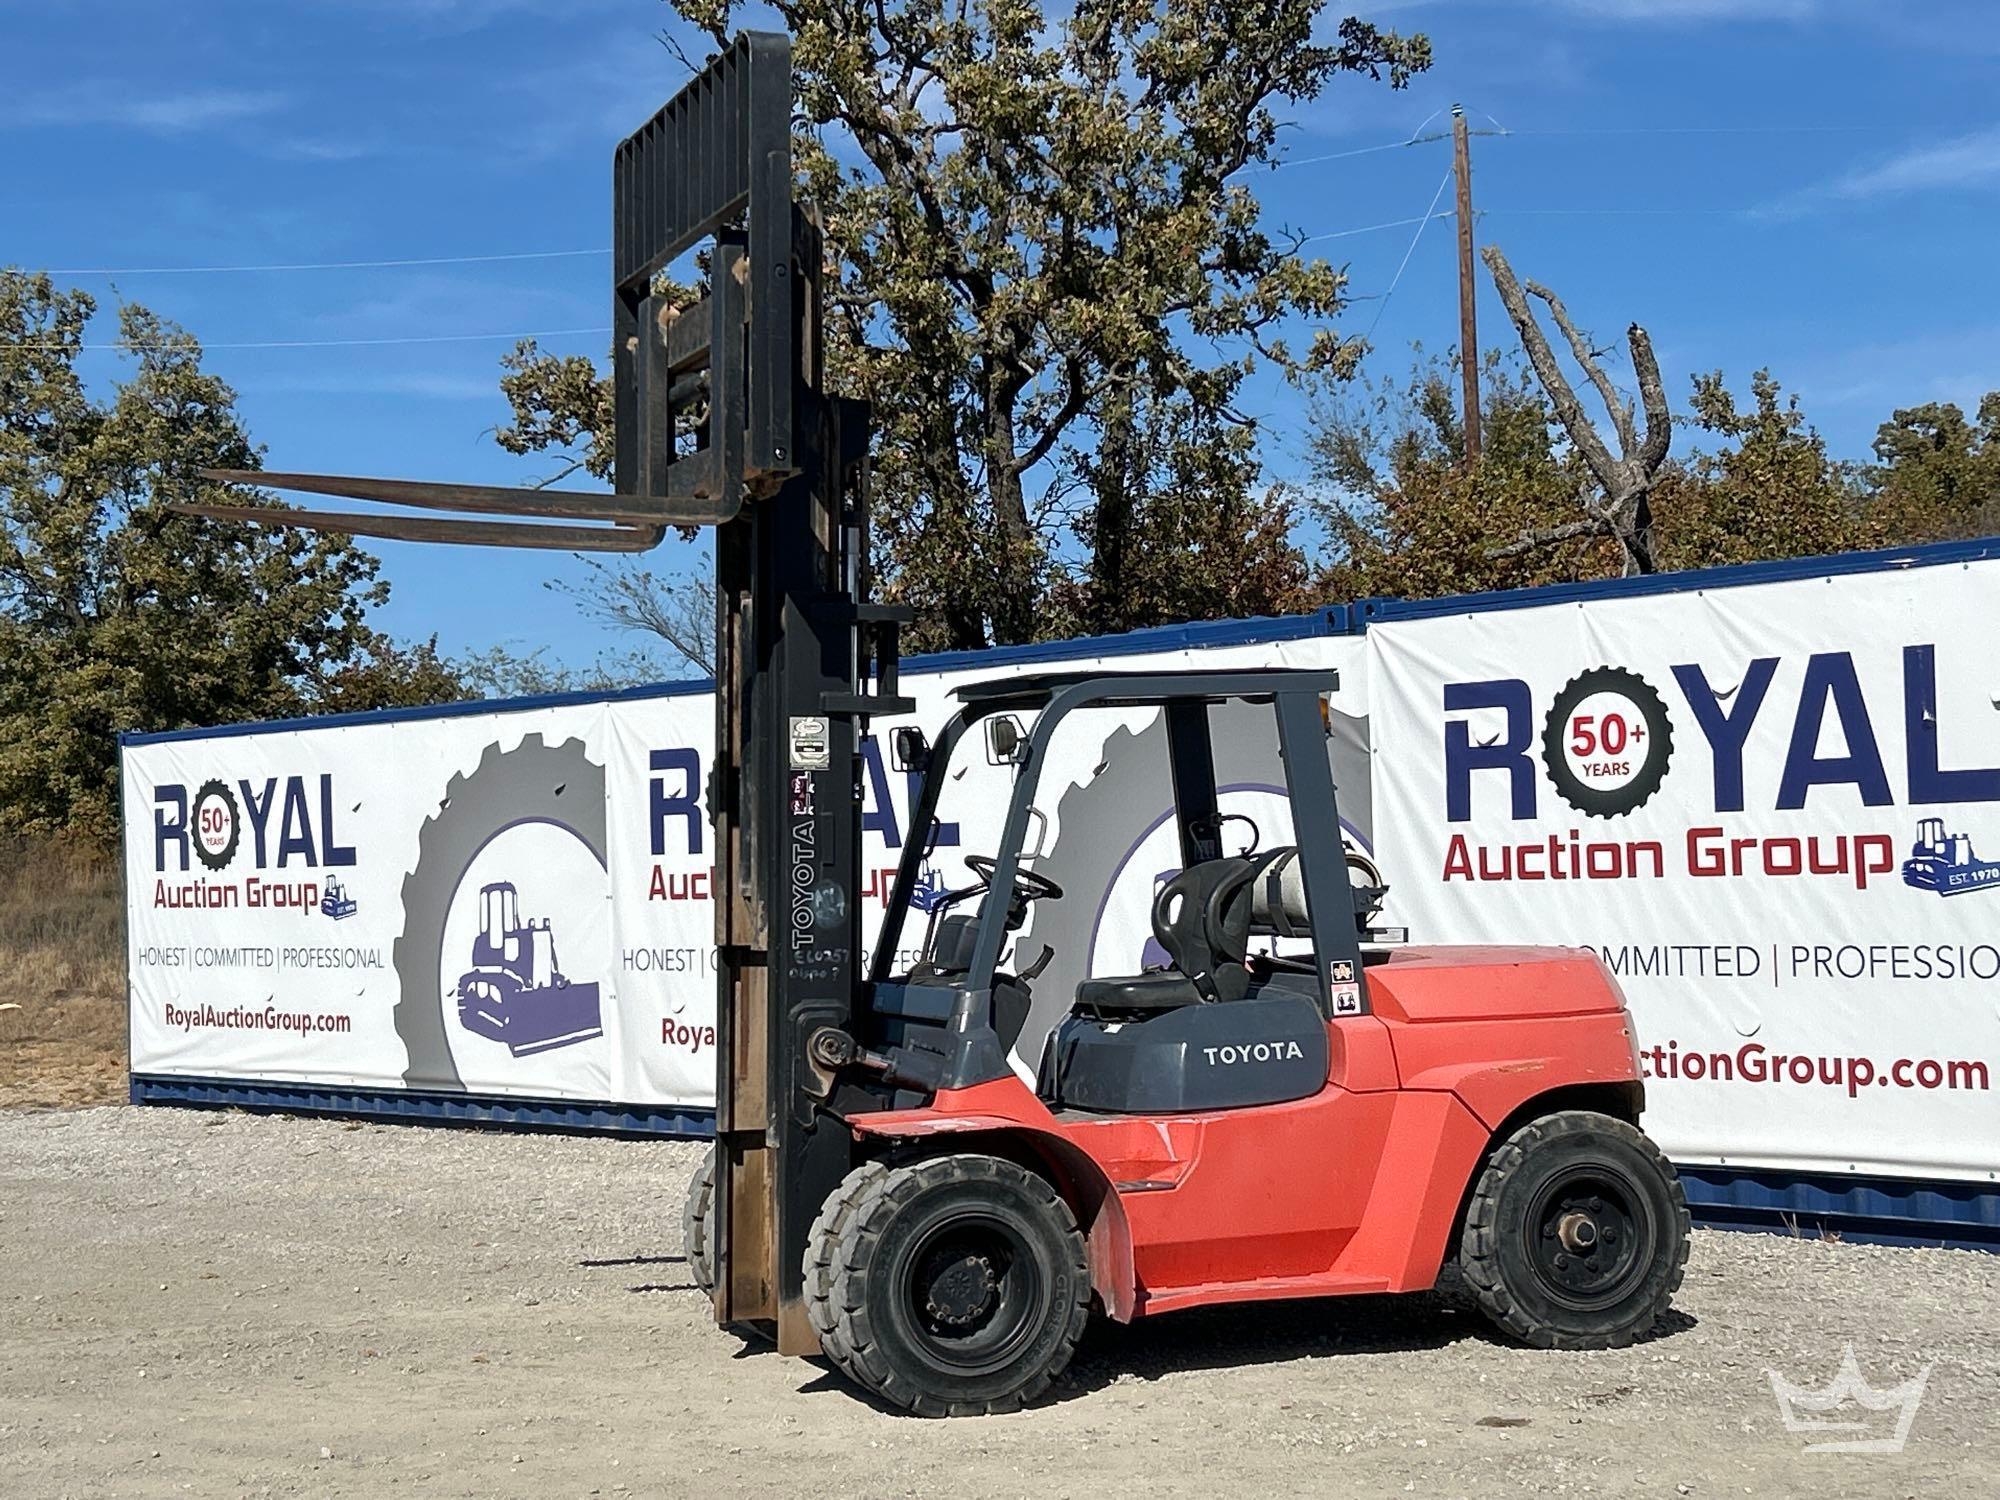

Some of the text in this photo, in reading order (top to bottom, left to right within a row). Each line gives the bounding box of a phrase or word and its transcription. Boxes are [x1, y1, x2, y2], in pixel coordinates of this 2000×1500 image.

[1443, 643, 2000, 822] ROYAL
[1570, 712, 1645, 757] 50+
[1583, 762, 1630, 777] YEARS
[154, 773, 357, 872] ROYAL
[202, 807, 230, 833] 50+
[1442, 826, 1895, 890] Auction Group
[1971, 868, 1999, 882] 1970
[154, 877, 318, 915] Auction Group
[792, 820, 815, 950] TOYOTA
[139, 946, 385, 968] HONEST COMMITTED PROFESSIONAL
[623, 947, 697, 971] HONEST
[1580, 945, 1761, 977] MMITTED
[165, 1003, 351, 1037] RoyalAuctionGroup.com
[1204, 1041, 1304, 1066] TOYOTA
[1640, 1040, 1990, 1097] ctionGroup.com
